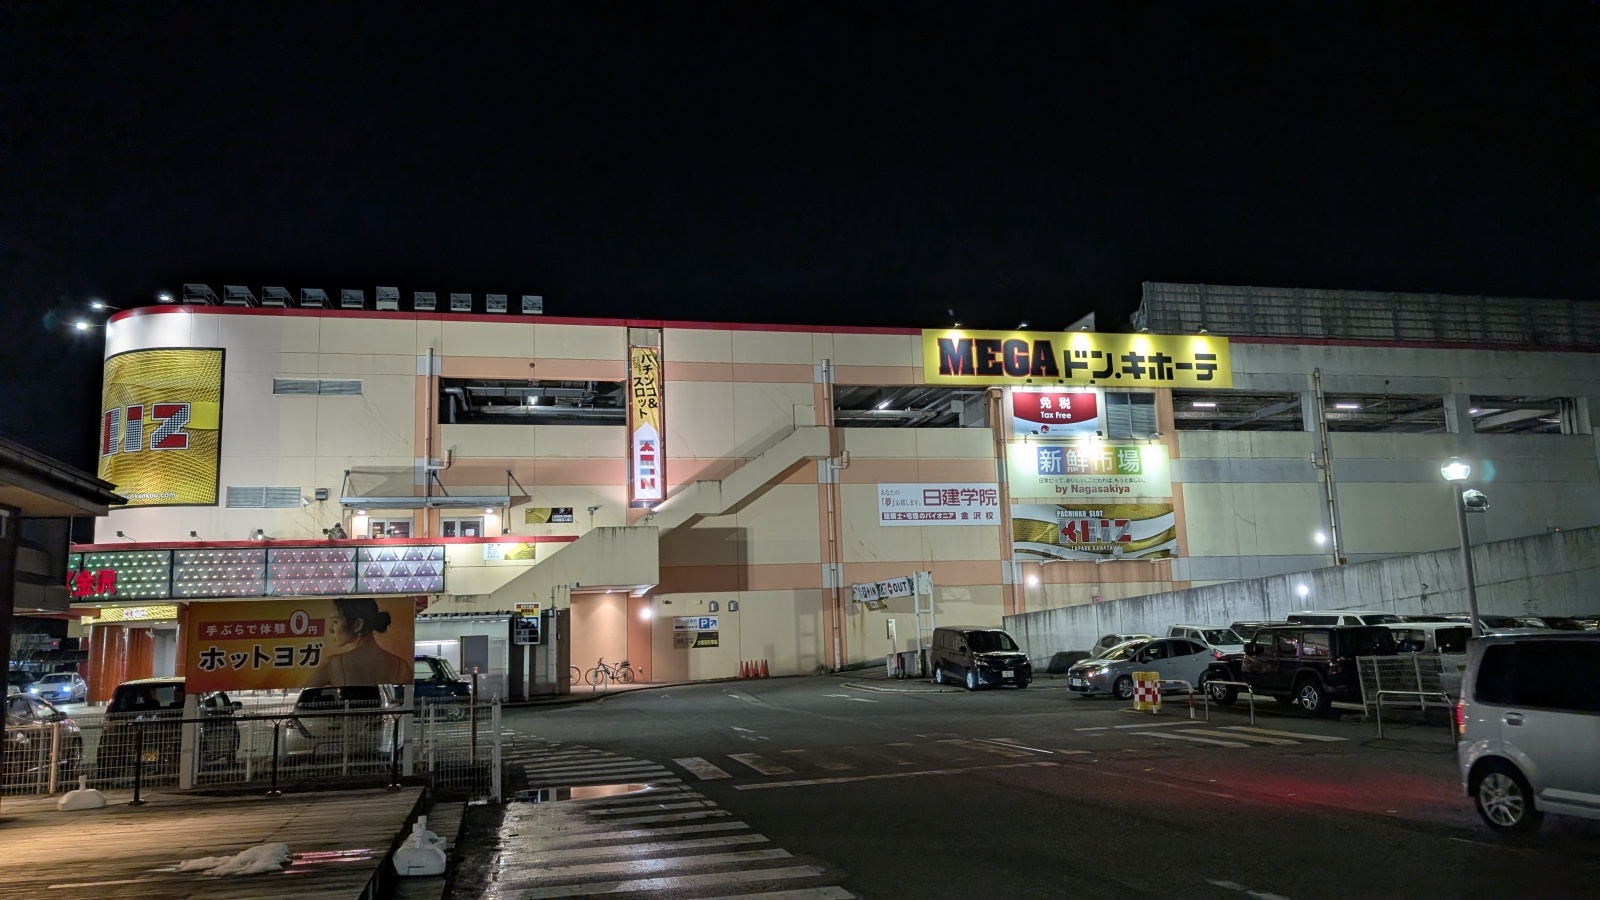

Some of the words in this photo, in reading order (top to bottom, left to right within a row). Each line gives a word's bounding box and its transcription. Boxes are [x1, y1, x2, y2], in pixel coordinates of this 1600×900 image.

[937, 337, 1059, 378] MEGA
[633, 376, 648, 419] スロット
[1039, 396, 1072, 410] 免税
[1040, 411, 1054, 419] Tax
[1056, 411, 1072, 420] Free
[1039, 449, 1140, 473] 新鮮市場
[1055, 484, 1068, 494] by
[1071, 484, 1130, 494] Nagasakiya
[923, 488, 997, 507] 日建学院
[961, 511, 994, 520] 金沢校
[1057, 510, 1087, 518] PACHINKO
[893, 582, 907, 593] OUT
[199, 643, 324, 671] ホットヨガ
